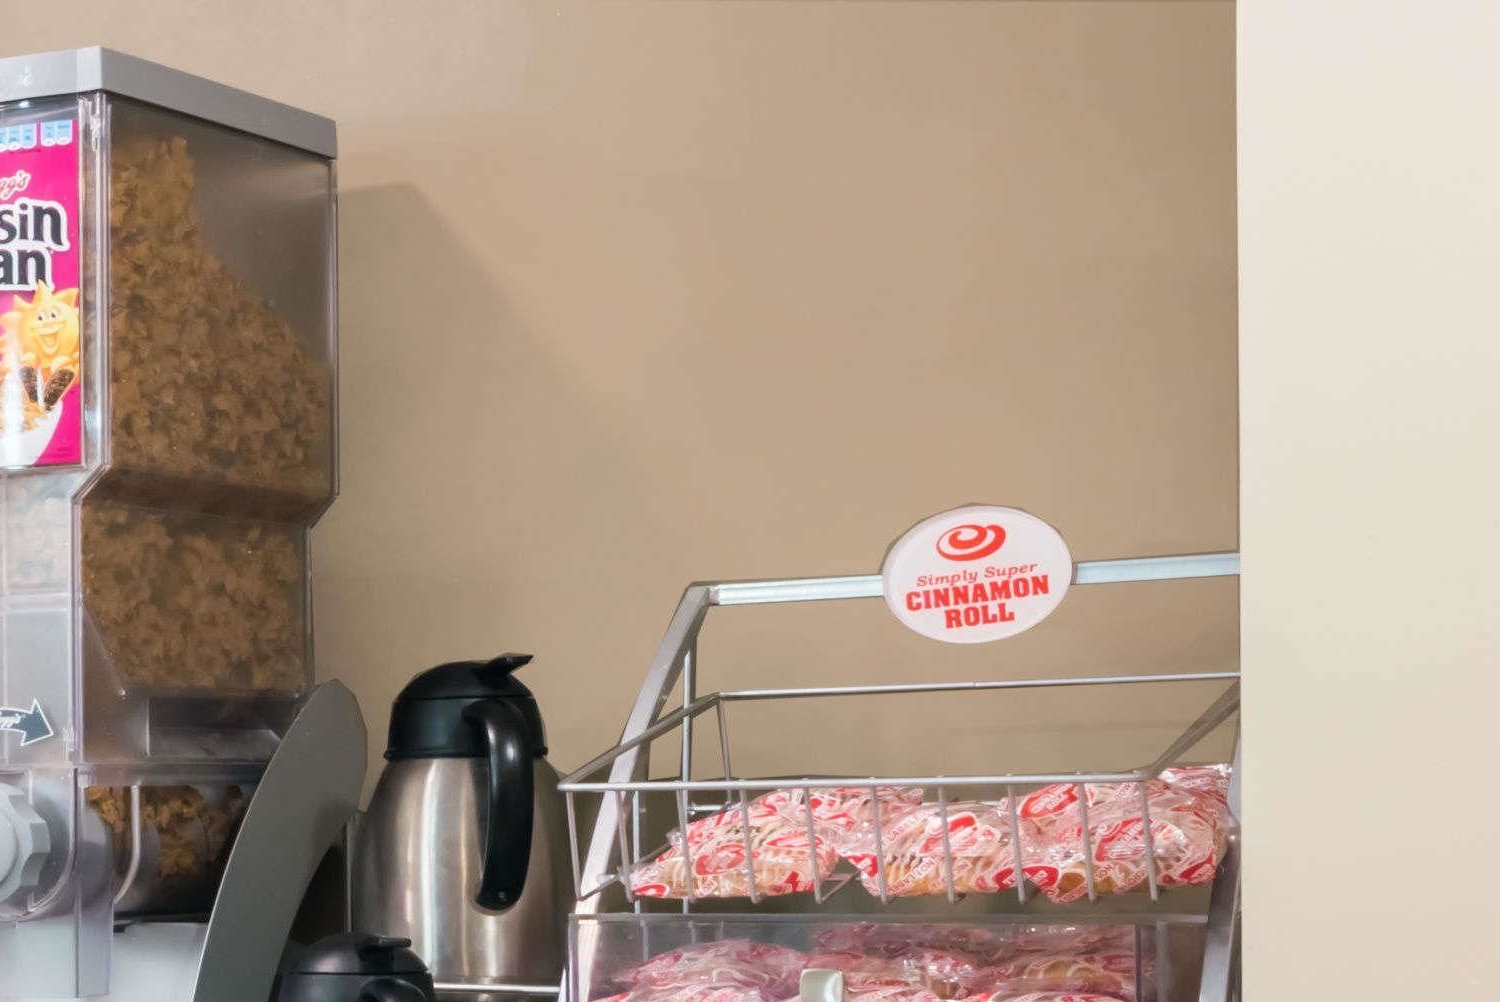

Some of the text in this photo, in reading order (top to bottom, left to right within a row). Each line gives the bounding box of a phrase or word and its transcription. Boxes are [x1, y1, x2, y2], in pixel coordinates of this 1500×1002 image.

[916, 562, 1038, 588] Simply Super
[905, 574, 1050, 612] CINNAMON
[944, 602, 1016, 630] ROLL
